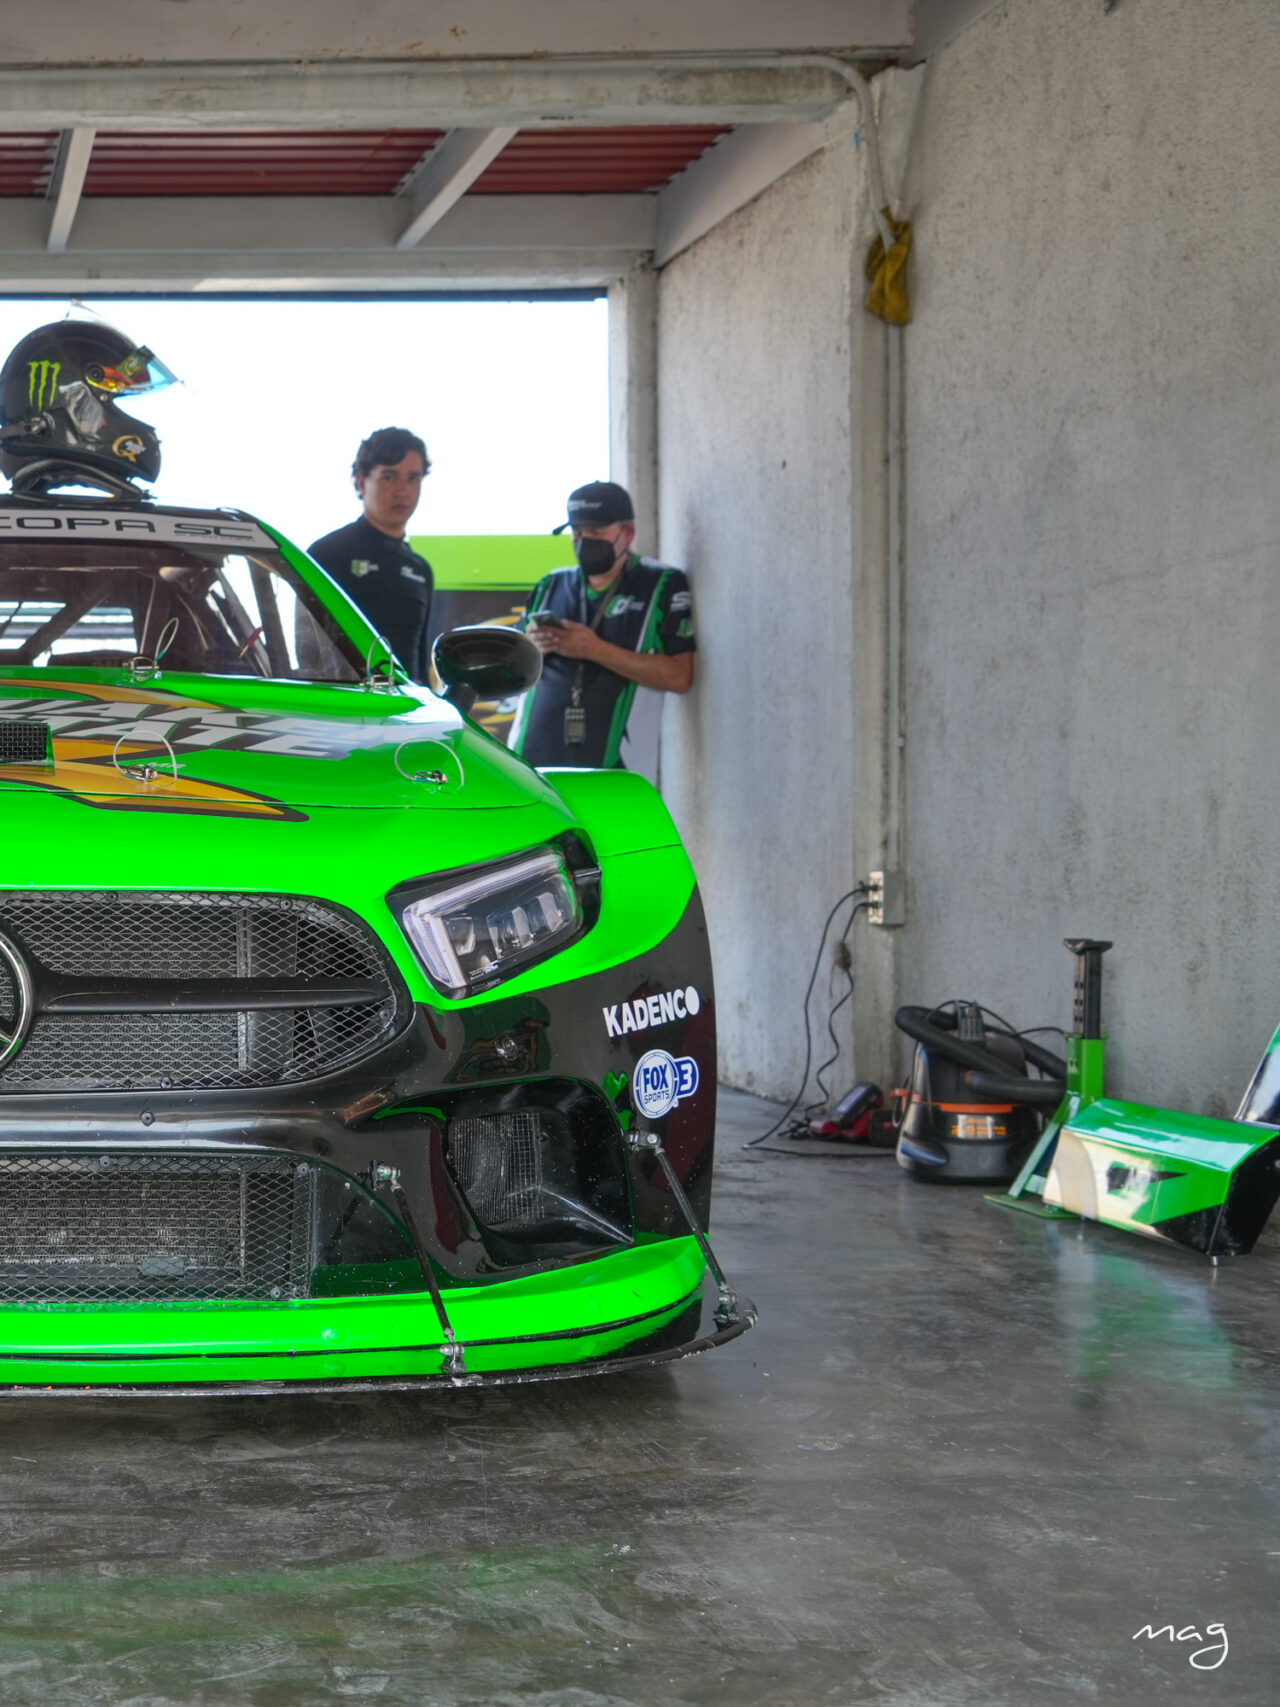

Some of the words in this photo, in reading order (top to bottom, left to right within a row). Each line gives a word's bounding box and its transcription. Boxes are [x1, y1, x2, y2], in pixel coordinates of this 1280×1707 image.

[602, 985, 700, 1038] KADENCO
[643, 1063, 669, 1093] FOX
[680, 1062, 693, 1092] 3
[644, 1089, 670, 1105] SPORTS
